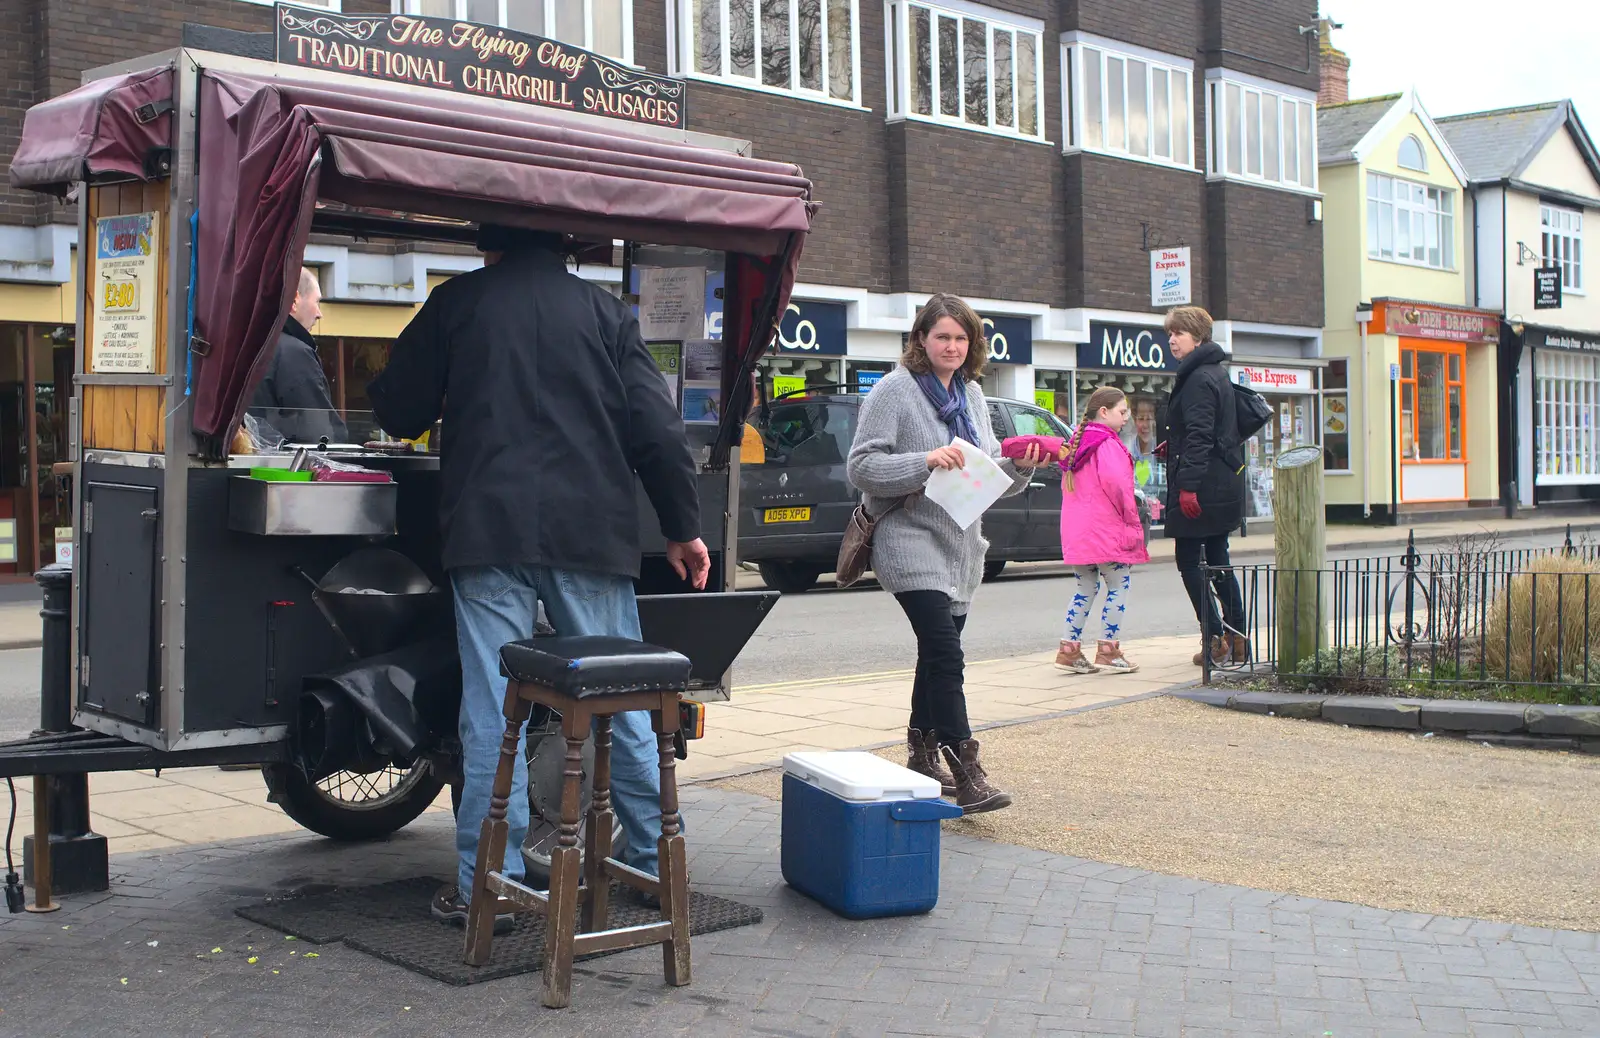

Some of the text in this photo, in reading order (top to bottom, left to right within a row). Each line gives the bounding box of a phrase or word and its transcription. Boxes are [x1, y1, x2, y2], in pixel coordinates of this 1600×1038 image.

[387, 16, 587, 79] The Flying Chef
[289, 34, 678, 124] TRADITIONAL CHARGRILL SAUSAGES
[1162, 252, 1178, 260] Diss
[1155, 261, 1186, 270] Express
[1161, 277, 1180, 288] Local
[769, 303, 820, 350] Co.
[1445, 315, 1484, 333] DRAGON
[1102, 328, 1166, 368] M&Co.
[1265, 369, 1297, 386] Express
[790, 509, 806, 519] XPG
